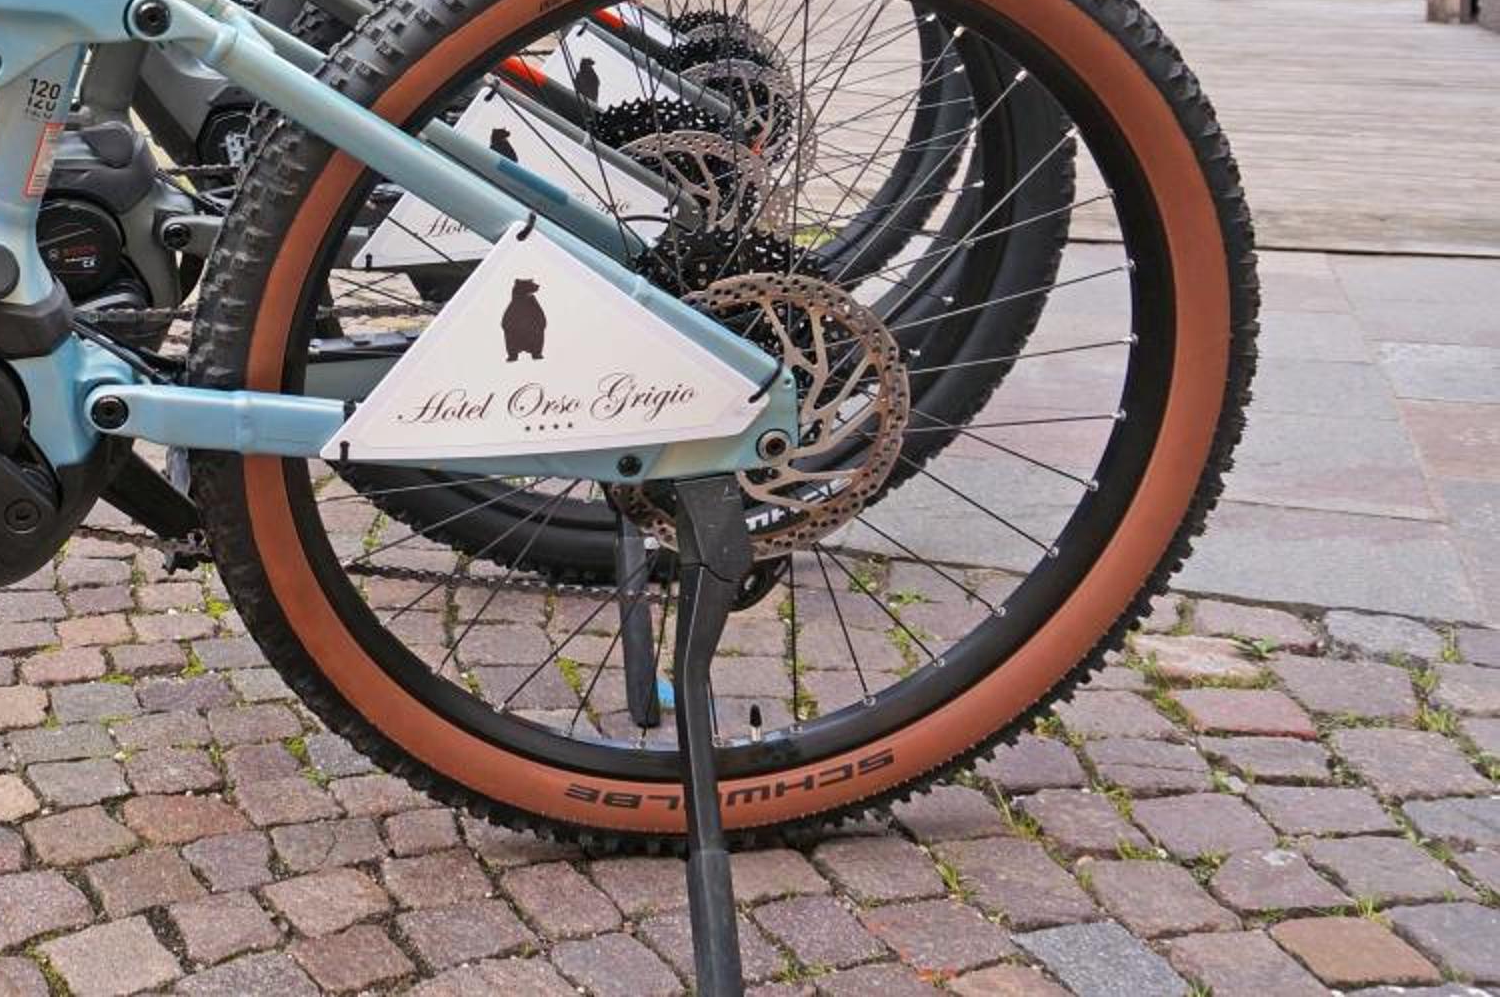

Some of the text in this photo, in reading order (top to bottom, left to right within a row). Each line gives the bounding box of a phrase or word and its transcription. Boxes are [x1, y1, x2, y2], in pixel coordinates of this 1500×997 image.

[29, 77, 61, 100] 120
[398, 372, 695, 424] Hotel Orso Grigio
[563, 748, 895, 811] SCHWLBE
